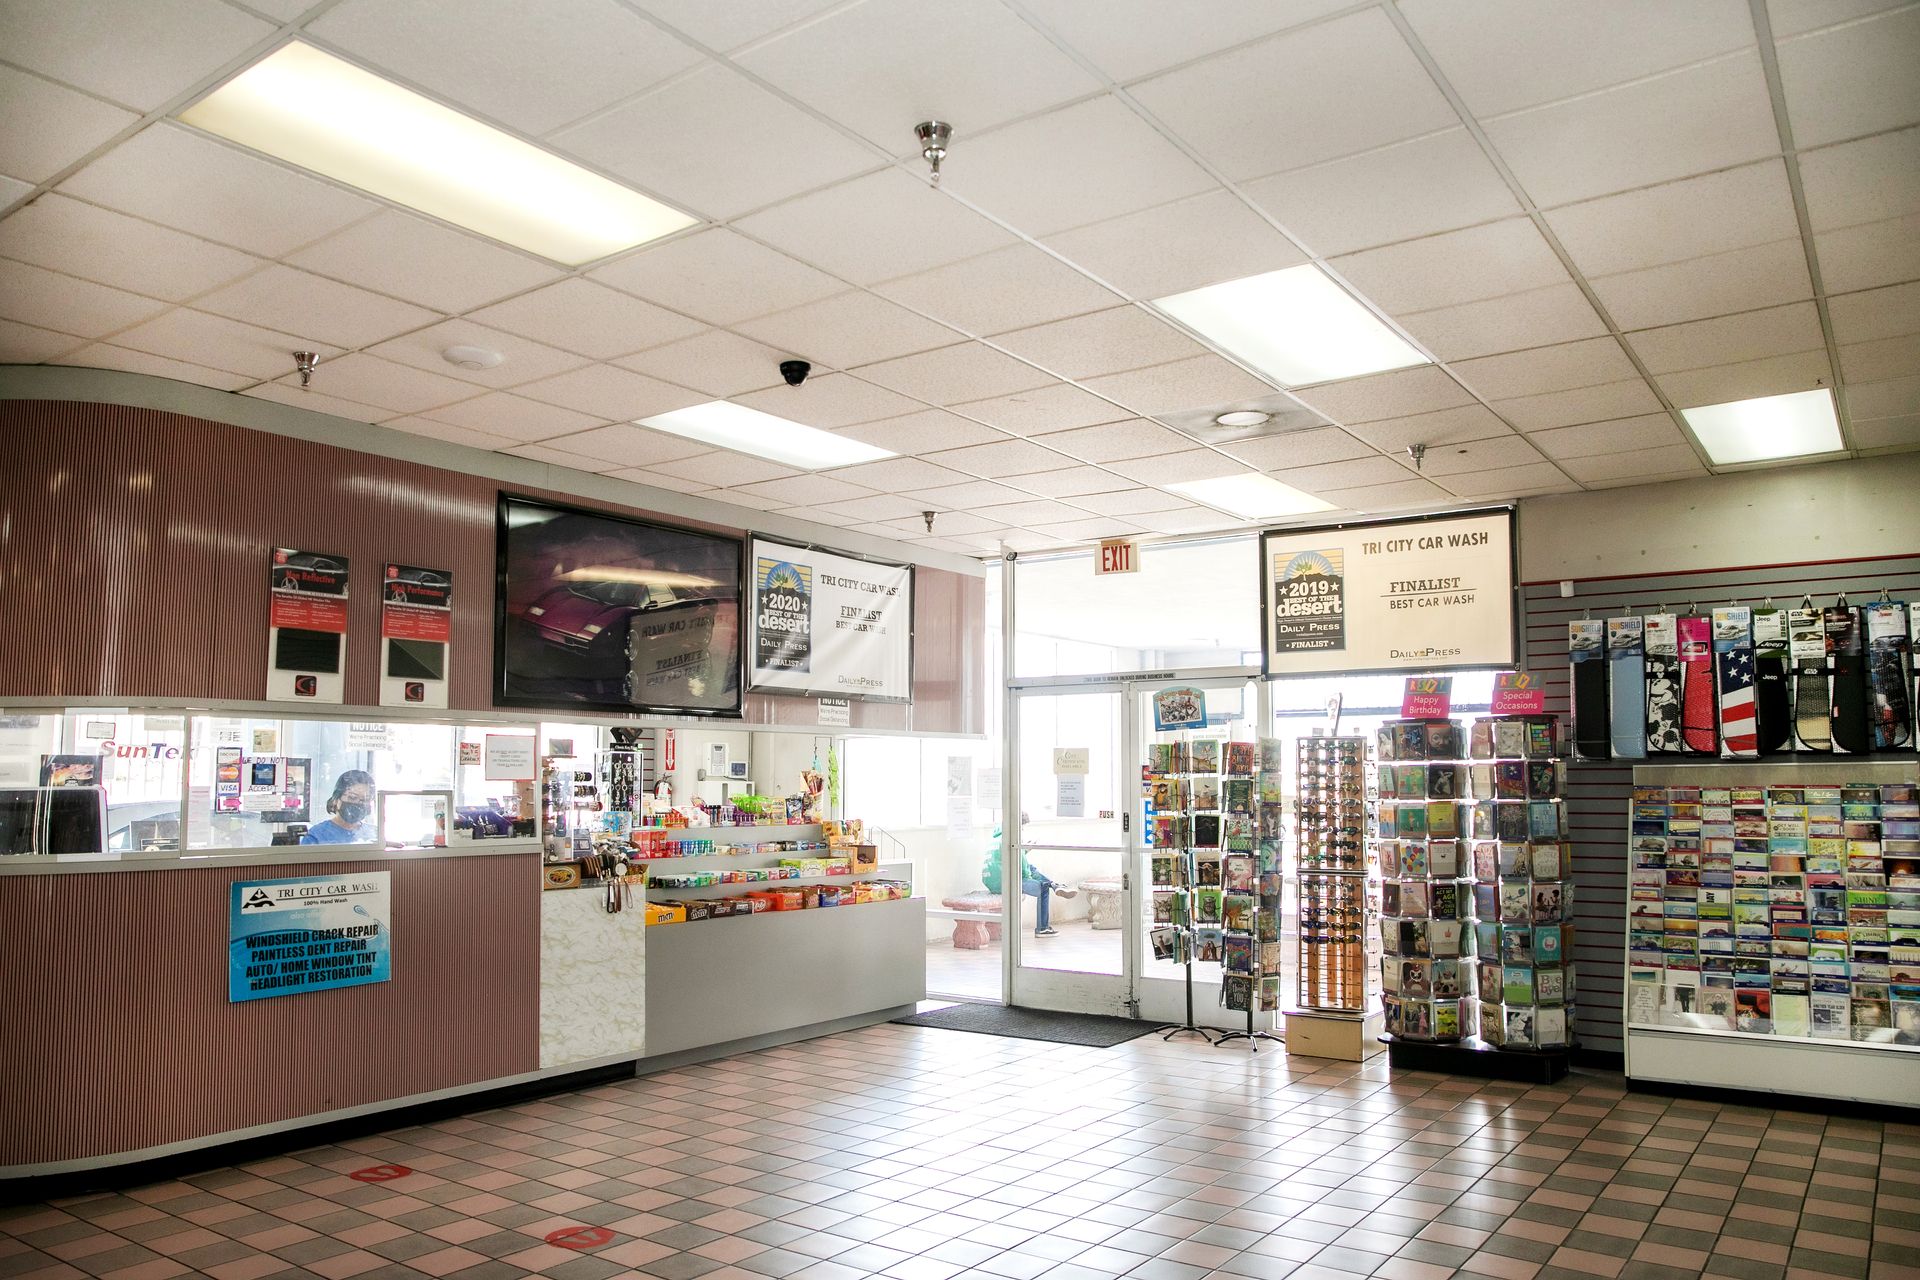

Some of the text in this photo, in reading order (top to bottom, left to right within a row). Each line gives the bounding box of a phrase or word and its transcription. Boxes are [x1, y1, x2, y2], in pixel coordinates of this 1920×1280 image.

[1362, 532, 1488, 555] TRI CITY CAR WASH
[1102, 544, 1131, 572] EXIT
[286, 570, 300, 580] Non
[821, 574, 836, 585] TRI
[838, 578, 858, 590] CITY
[860, 582, 878, 593] CAR
[1289, 580, 1328, 598] 2019
[1390, 577, 1460, 592] FINALIST
[769, 593, 800, 612] 2020
[1277, 595, 1342, 617] desert
[1390, 594, 1475, 610] BEST CAR WASH
[759, 609, 809, 634] desert
[1610, 621, 1641, 630] SUNSHIELD
[770, 658, 799, 667] FINALIST
[1414, 696, 1439, 706] Happy
[1503, 691, 1533, 700] Special
[1409, 706, 1441, 715] Birthday
[1496, 702, 1537, 710] Occasions
[278, 889, 294, 898] TRI
[300, 887, 323, 896] CITY
[327, 885, 346, 894] CAR
[246, 924, 378, 949] WINDSHIELD CRACK REPAIR
[251, 939, 366, 962] PAINTLESS DENT REPAIR
[246, 952, 376, 978] AUTO/ HOME WINDOW TINT
[250, 965, 372, 991] HEADLIGHT RESTORATION
